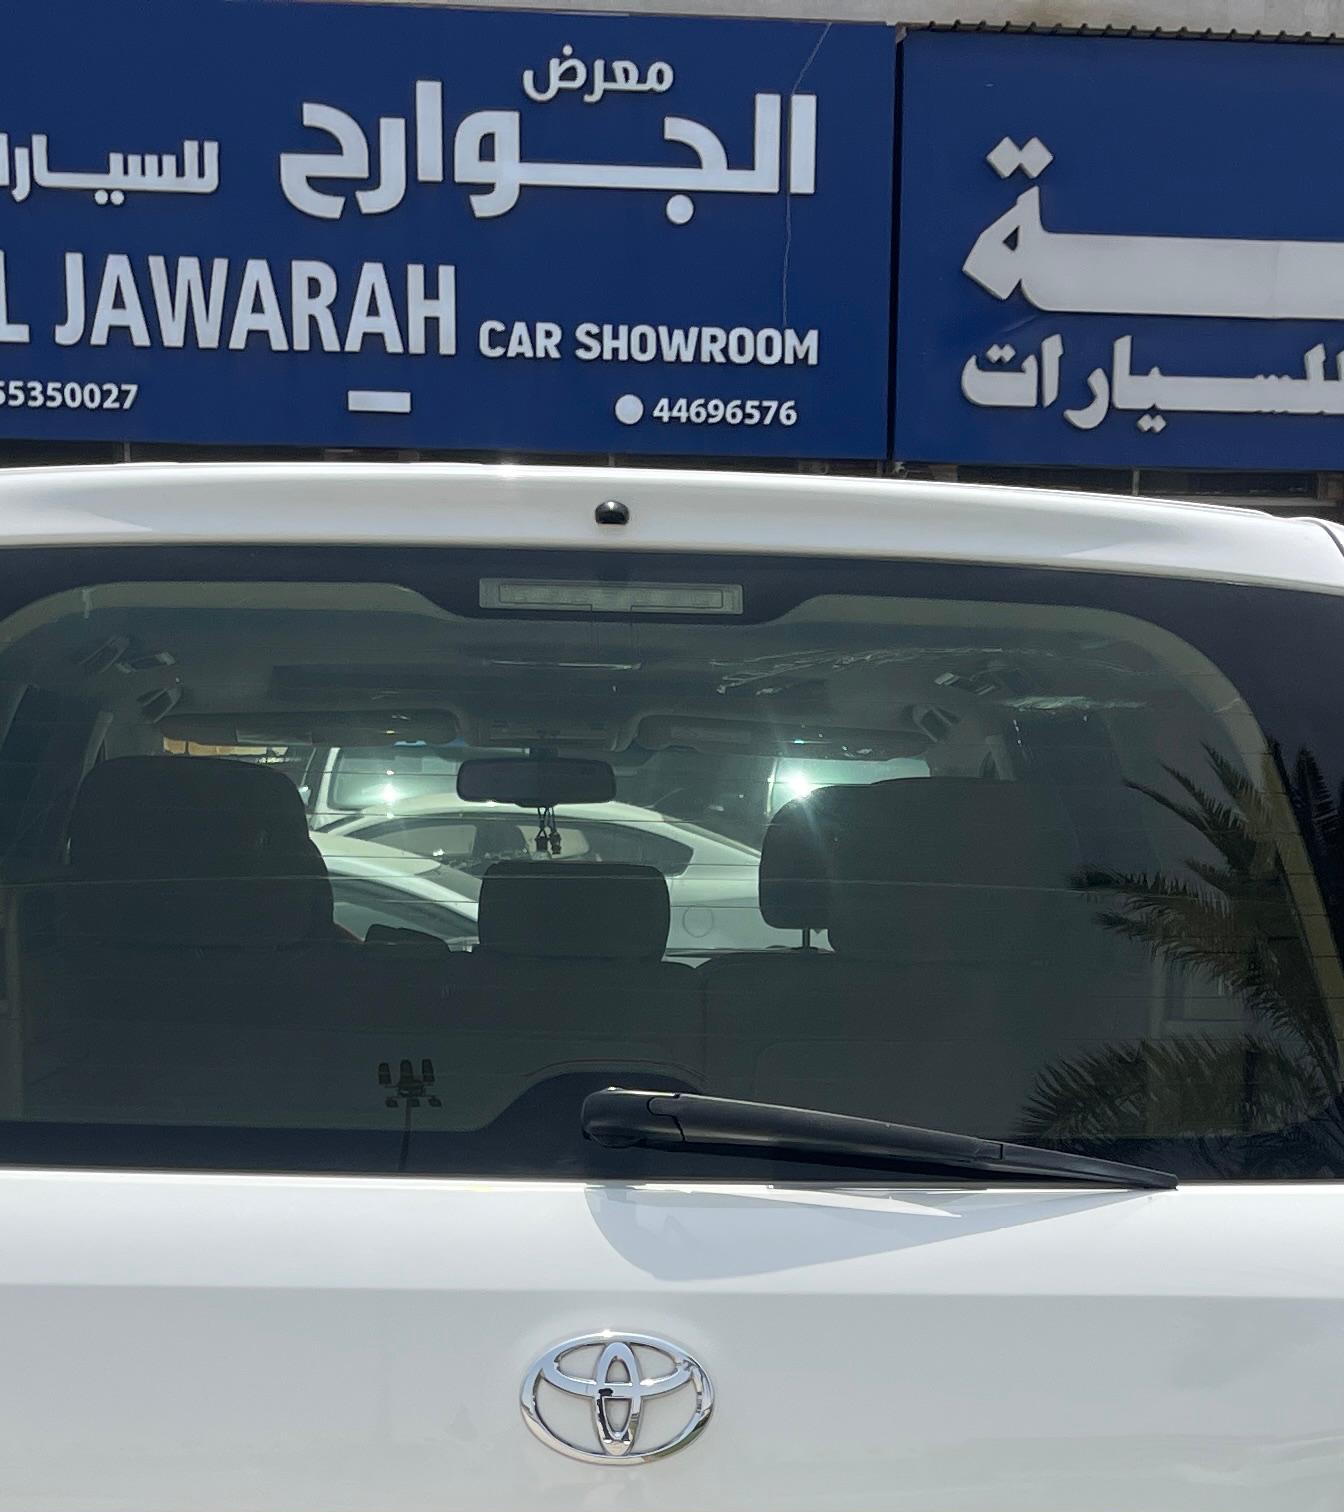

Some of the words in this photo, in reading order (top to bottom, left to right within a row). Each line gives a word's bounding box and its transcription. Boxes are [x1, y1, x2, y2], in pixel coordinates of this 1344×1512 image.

[522, 44, 673, 102] معرض
[279, 79, 817, 225] الجوارح
[55, 251, 456, 355] JAWARAH
[479, 320, 562, 359] CAR
[575, 322, 819, 365] SHOWROOM
[653, 397, 798, 425] 44696576
